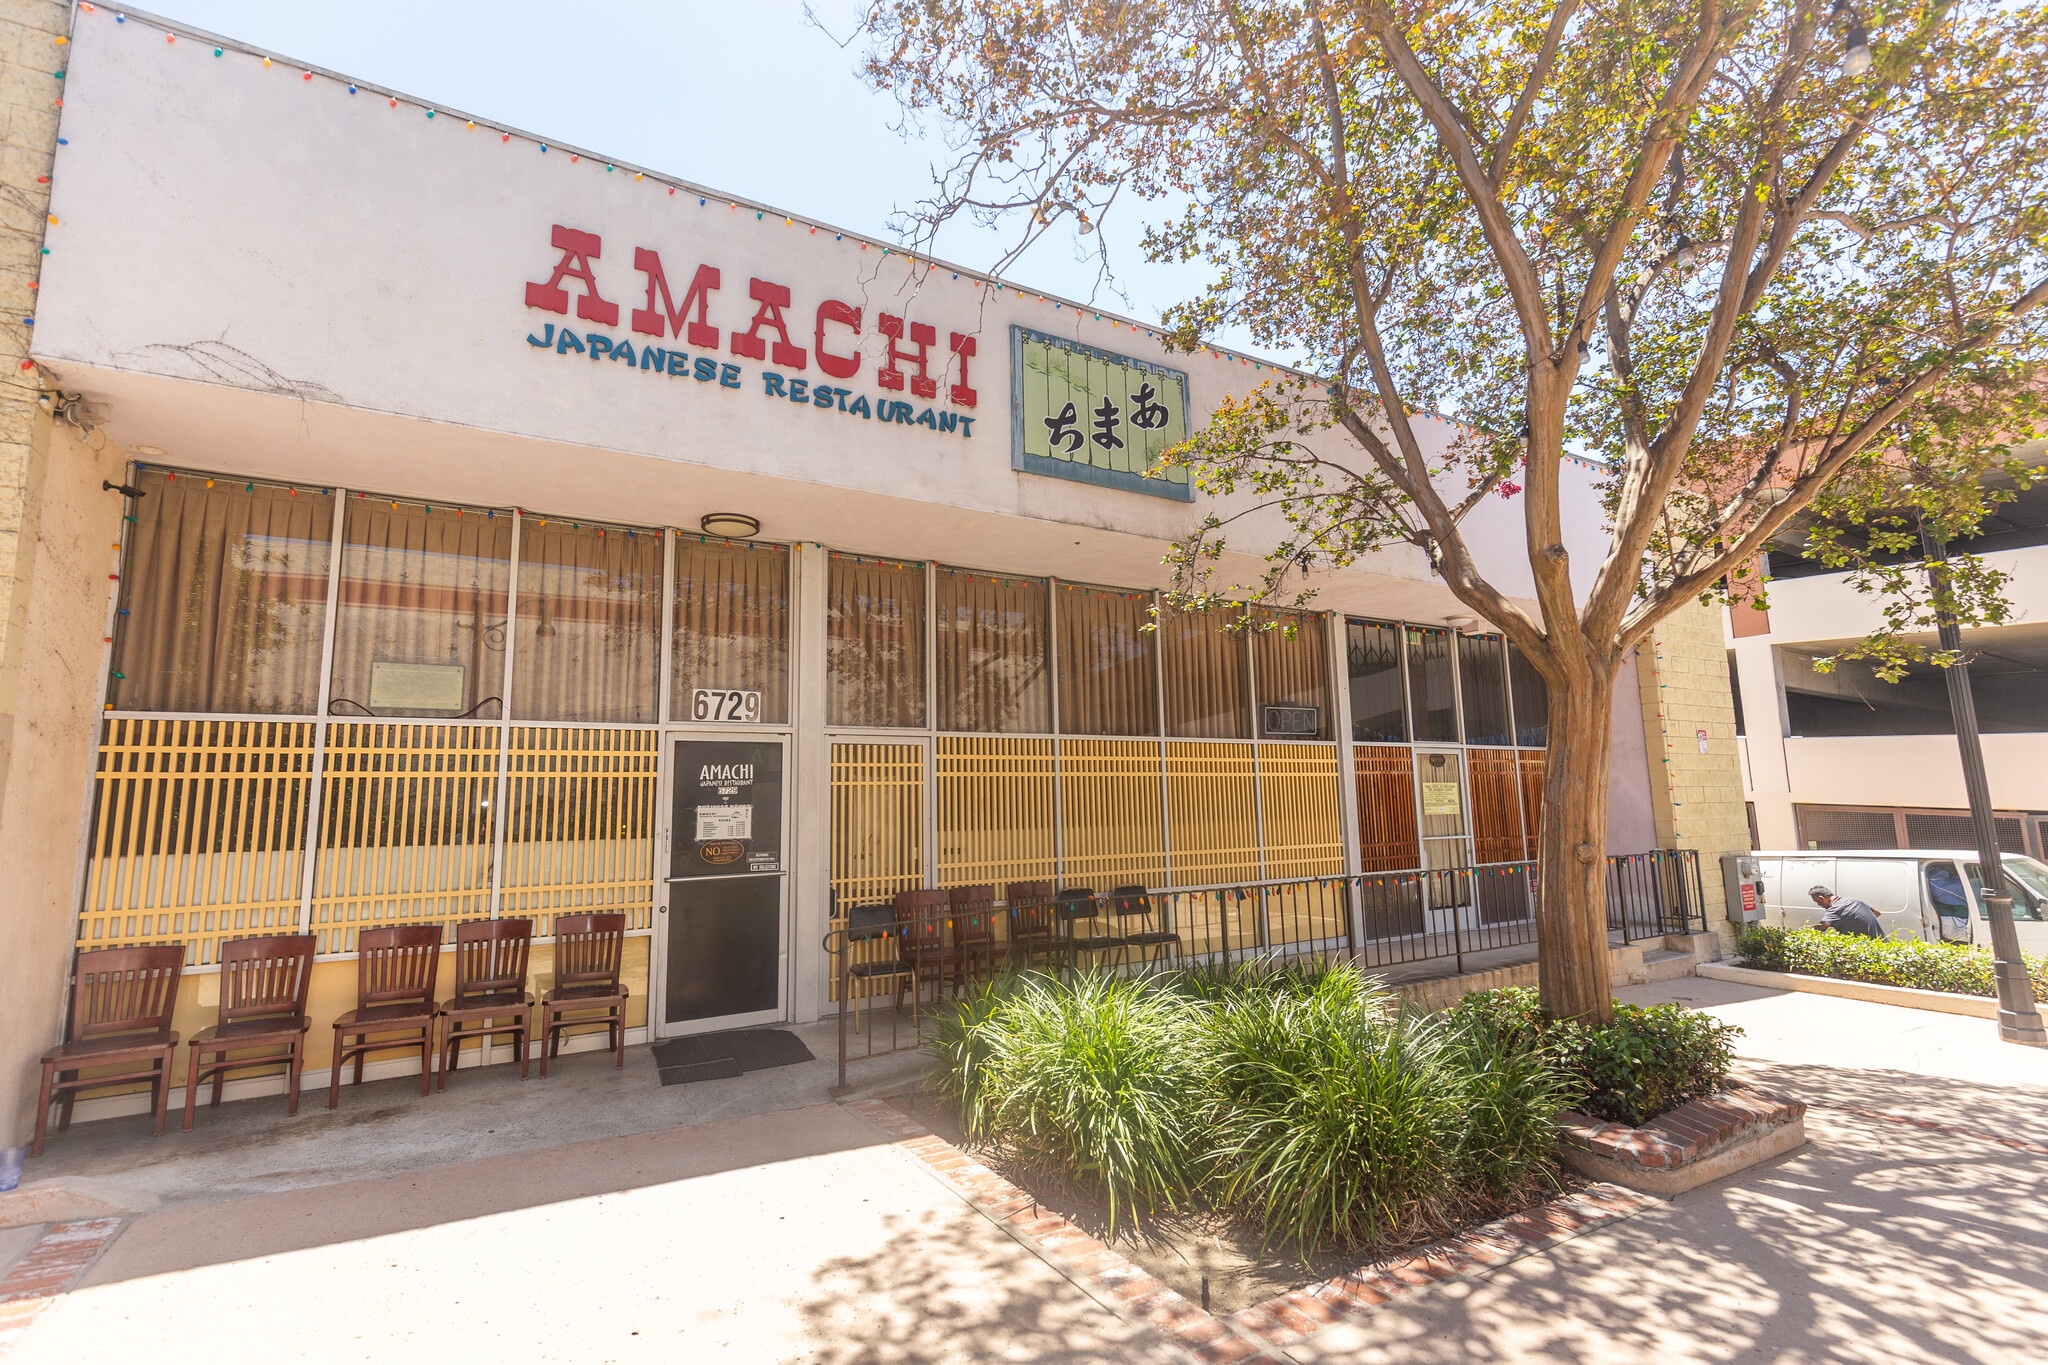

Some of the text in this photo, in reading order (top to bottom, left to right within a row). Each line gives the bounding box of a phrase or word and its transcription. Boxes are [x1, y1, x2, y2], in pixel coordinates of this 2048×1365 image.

[525, 224, 977, 408] AMACHI
[526, 323, 976, 437] JAPANESE RESTAURANT
[693, 690, 760, 721] 6729
[1267, 710, 1315, 732] OPEN
[699, 764, 754, 780] AMACHI
[705, 846, 721, 856] NO
